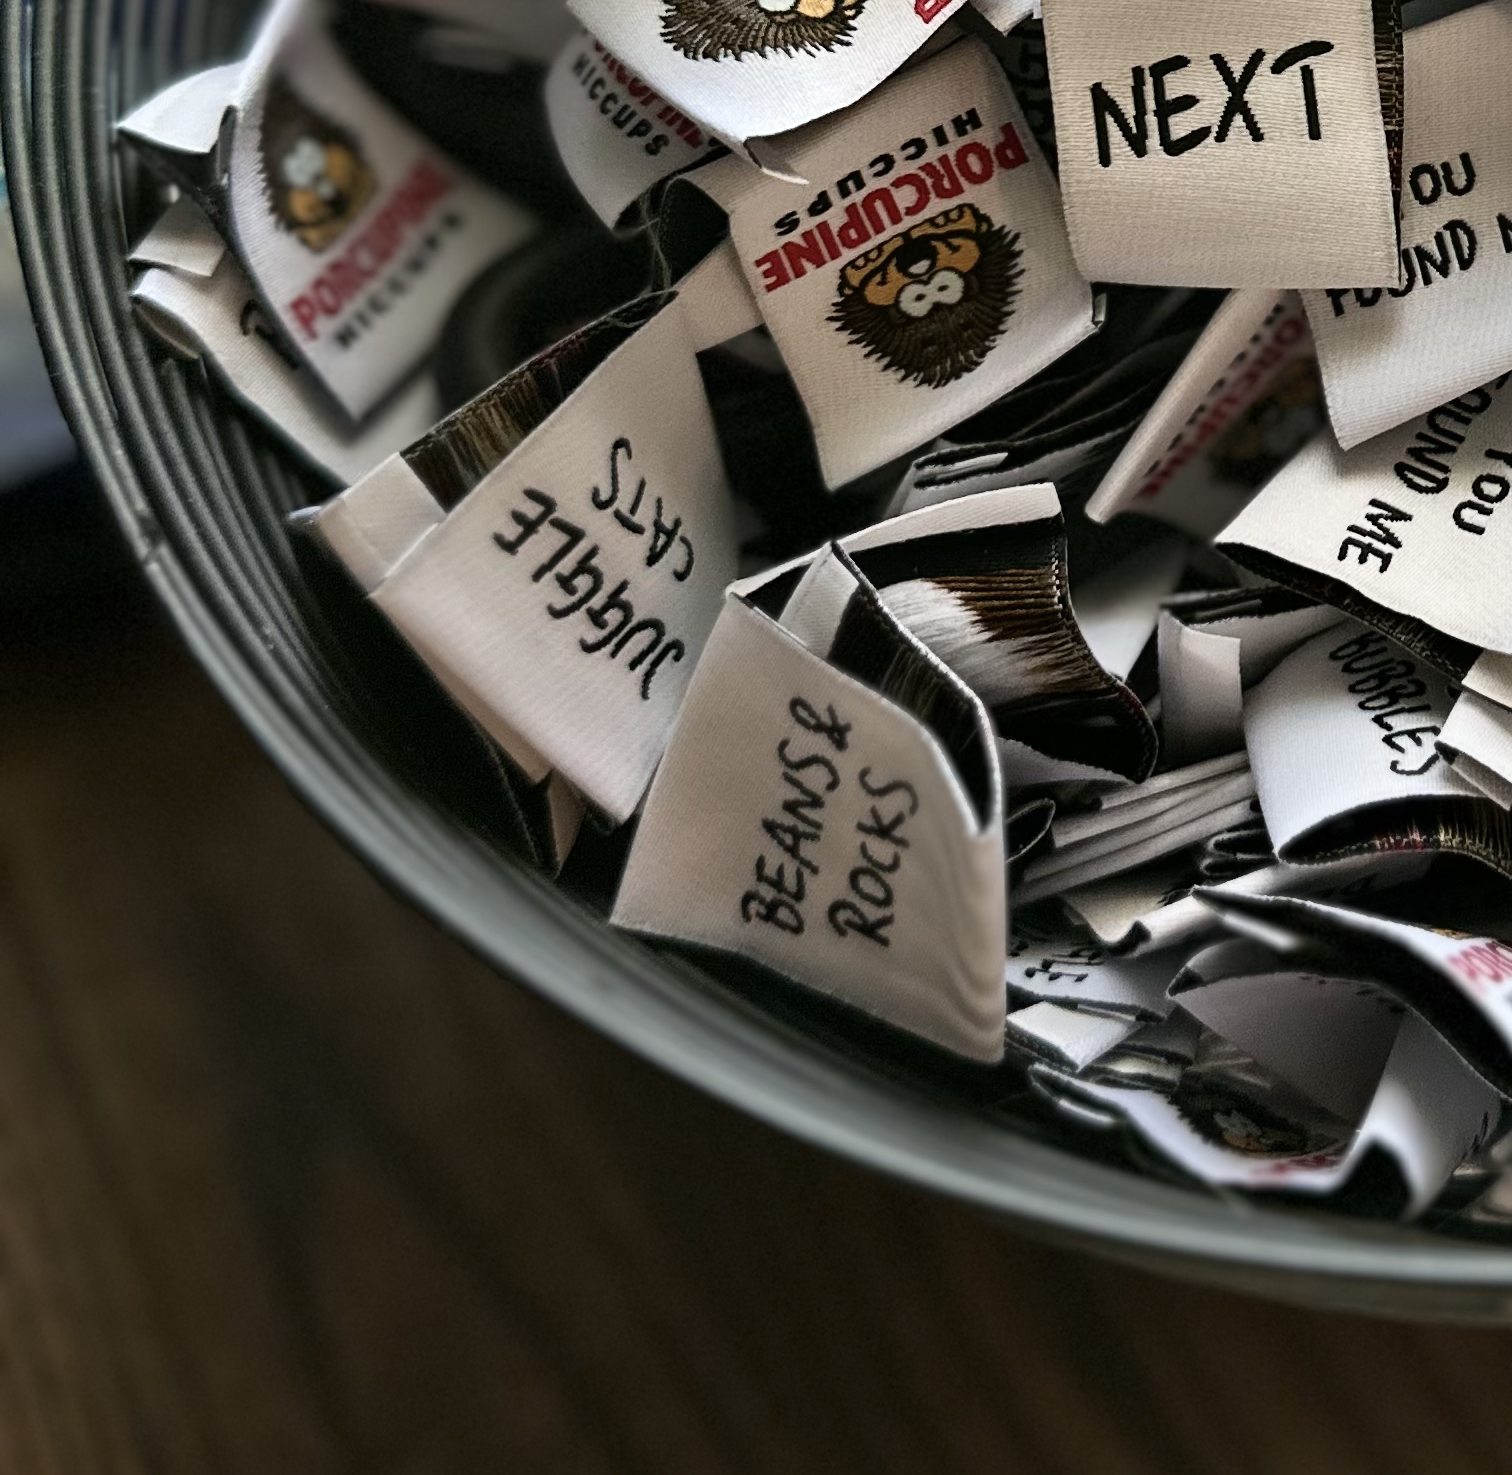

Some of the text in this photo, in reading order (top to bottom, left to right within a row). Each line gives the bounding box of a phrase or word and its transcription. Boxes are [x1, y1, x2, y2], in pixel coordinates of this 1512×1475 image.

[572, 52, 670, 158] HICCUPS
[775, 107, 983, 236] HICCUPS
[1089, 40, 1335, 168] NEXT
[753, 122, 1031, 293] PORCUPINE
[1409, 152, 1477, 207] OU
[591, 437, 695, 582] CATS
[1338, 364, 1512, 574] OUND ME
[493, 487, 687, 701] JUGGLE
[1328, 629, 1443, 778] BUBBLES
[828, 767, 919, 948] ROCKS
